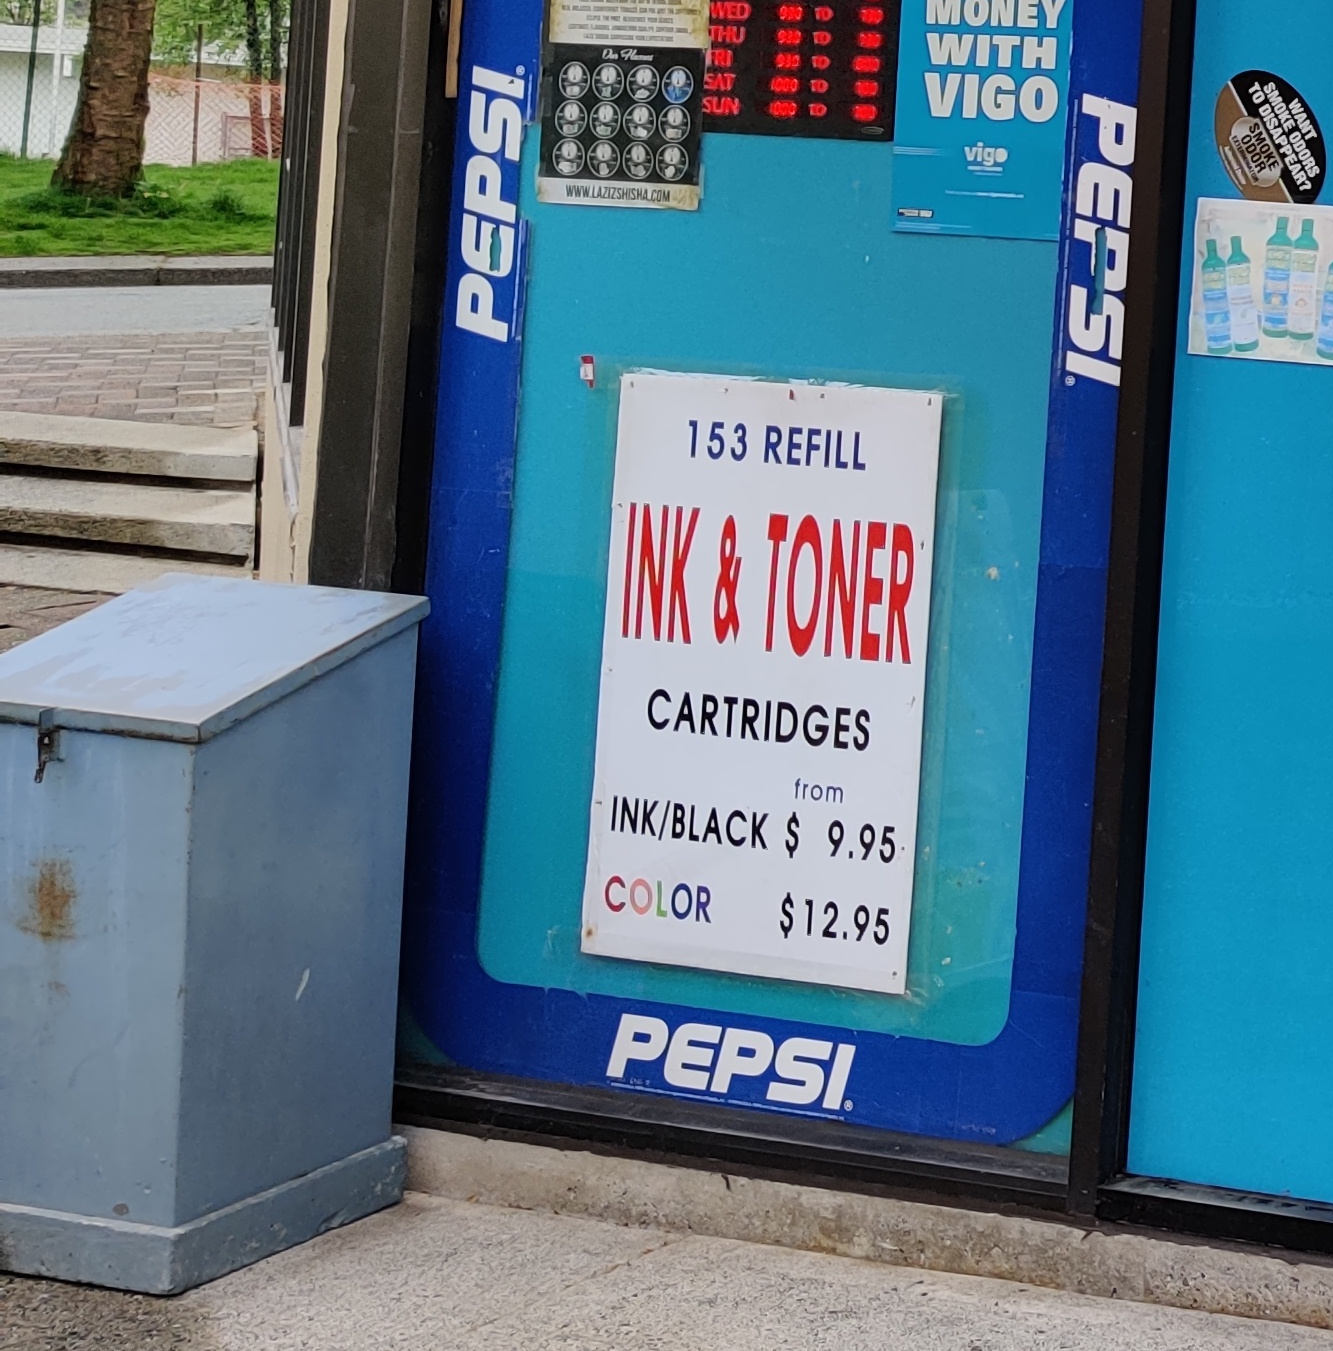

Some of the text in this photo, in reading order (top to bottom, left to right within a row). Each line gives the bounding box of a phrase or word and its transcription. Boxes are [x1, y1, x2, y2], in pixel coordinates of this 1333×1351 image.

[709, 25, 746, 43] THU
[710, 2, 751, 20] WED
[926, 32, 1057, 69] WITH
[702, 97, 740, 115] SUN
[704, 73, 736, 90] SAT
[924, 72, 1058, 123] VIGO
[1248, 82, 1312, 191] TO DISAPPEAR?
[1263, 82, 1320, 178] SMOKE ODORS
[1289, 98, 1317, 141] WANT
[964, 142, 1008, 166] vigo
[1241, 134, 1266, 173] ODOR
[1249, 122, 1279, 172] SMOKE
[455, 64, 525, 342] PEPSI
[566, 184, 670, 203] WWW.LAZIZSHISHA.COM
[1065, 93, 1138, 386] PEPSI
[687, 419, 866, 471] 153 REFILL
[621, 502, 915, 665] INK & TONER
[646, 688, 871, 752] CARTRIDGES
[794, 777, 844, 804] from
[610, 795, 897, 865] INK/BLACK $ 9.95
[604, 874, 891, 946] COLOR $12.95
[606, 1013, 856, 1112] PEPSI
